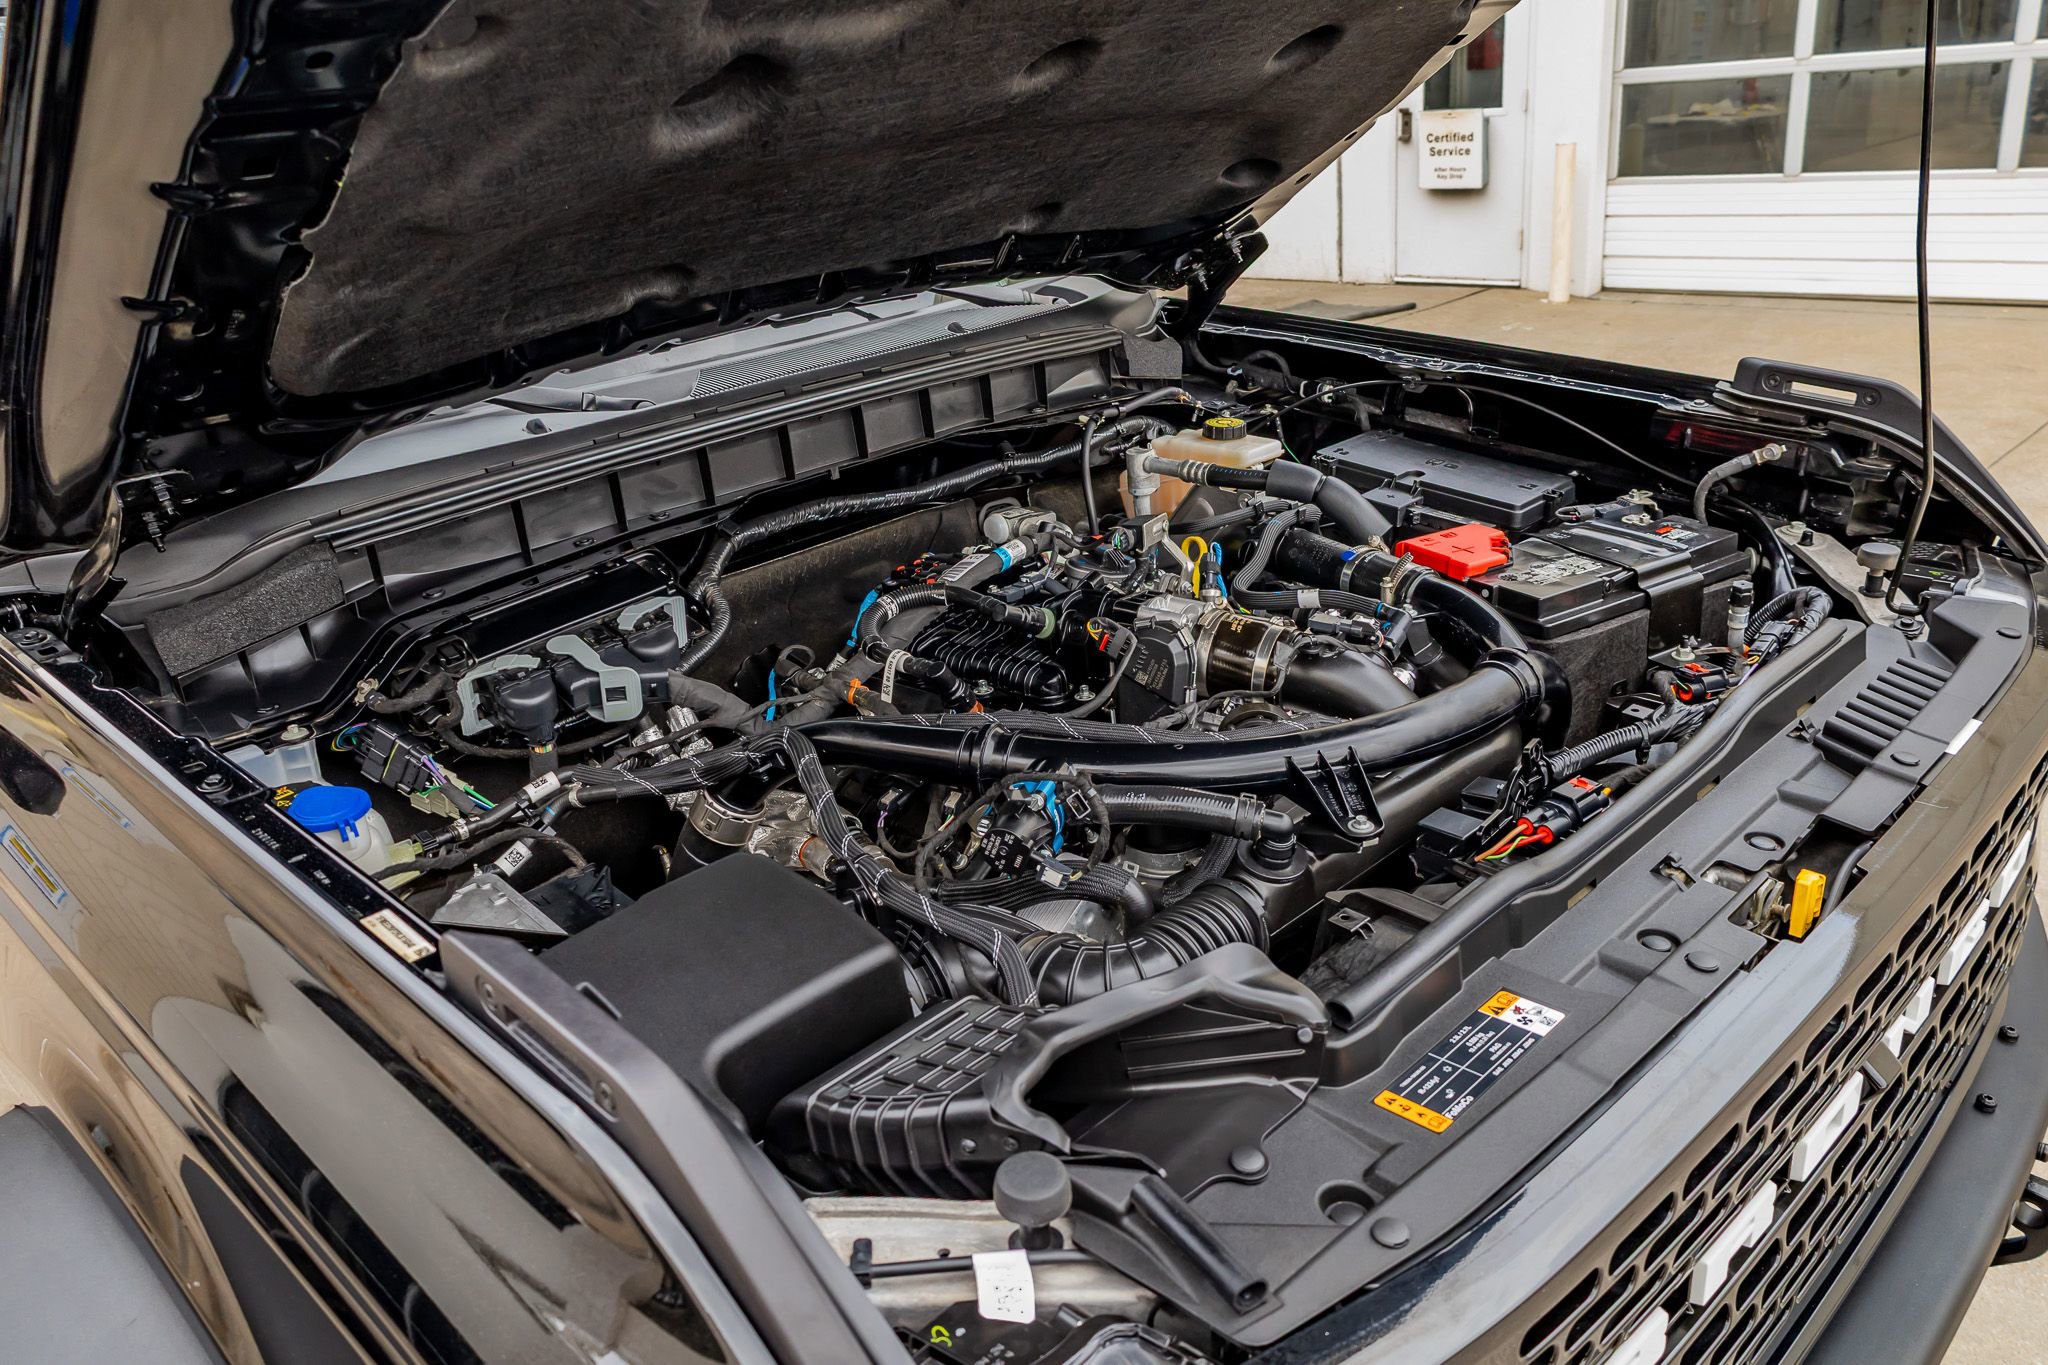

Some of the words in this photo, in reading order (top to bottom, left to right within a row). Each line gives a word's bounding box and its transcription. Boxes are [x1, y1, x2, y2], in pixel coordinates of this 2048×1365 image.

[1426, 131, 1474, 143] Certified
[1429, 146, 1471, 157] Service
[1444, 1095, 1475, 1120] FoMoCo
